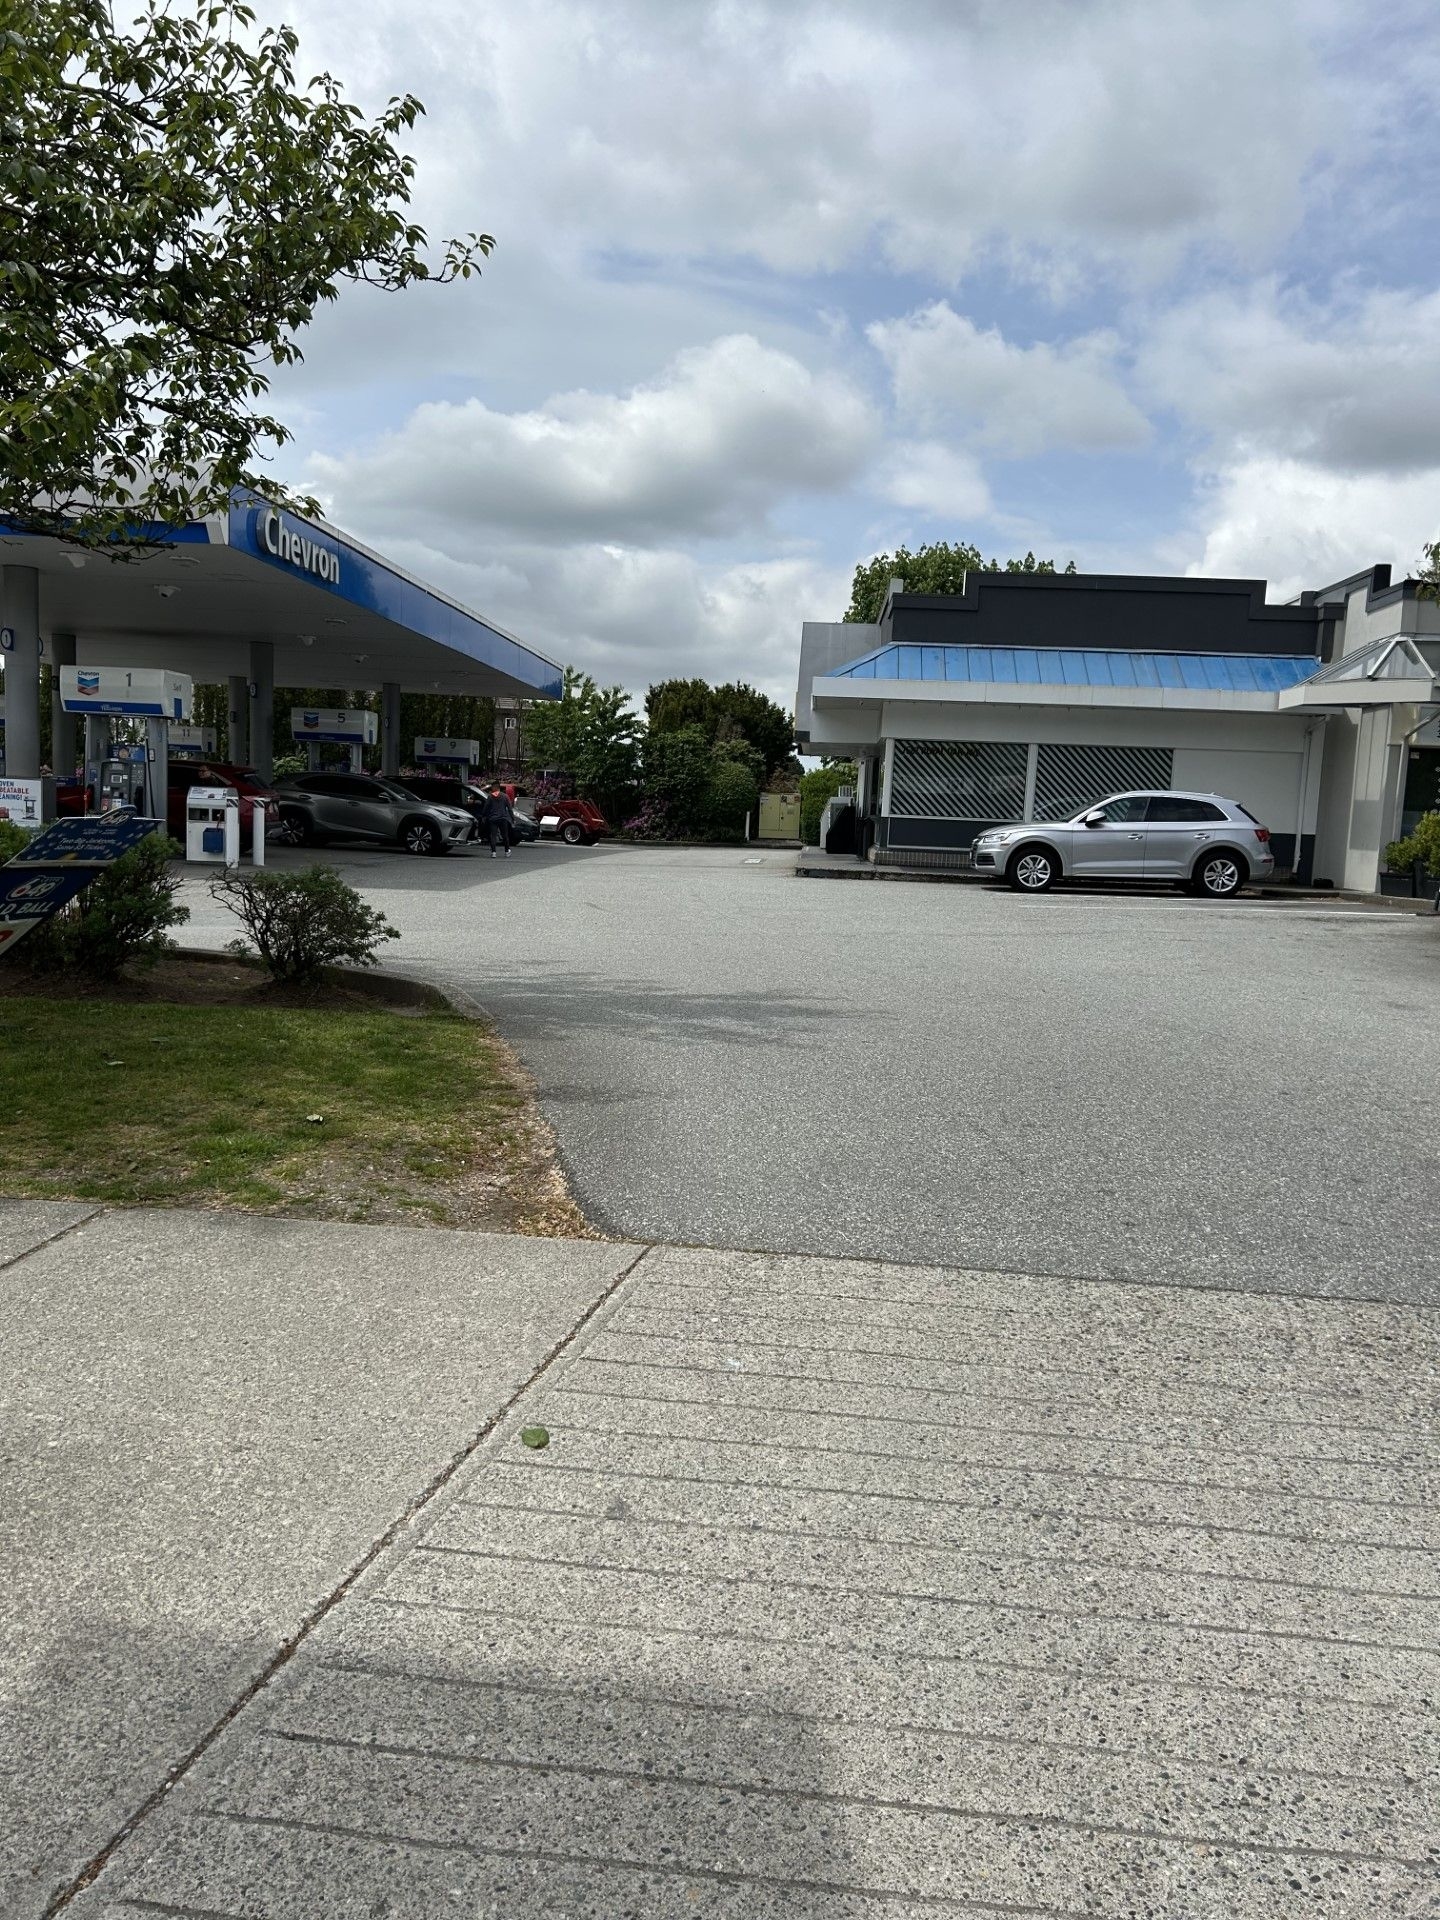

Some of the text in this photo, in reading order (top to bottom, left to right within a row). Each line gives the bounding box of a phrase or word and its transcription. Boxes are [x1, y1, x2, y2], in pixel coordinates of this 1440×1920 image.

[264, 509, 340, 585] Chevron
[125, 672, 132, 687] 1
[337, 712, 346, 723] 5
[182, 728, 190, 737] 11
[16, 901, 56, 915] BALL
